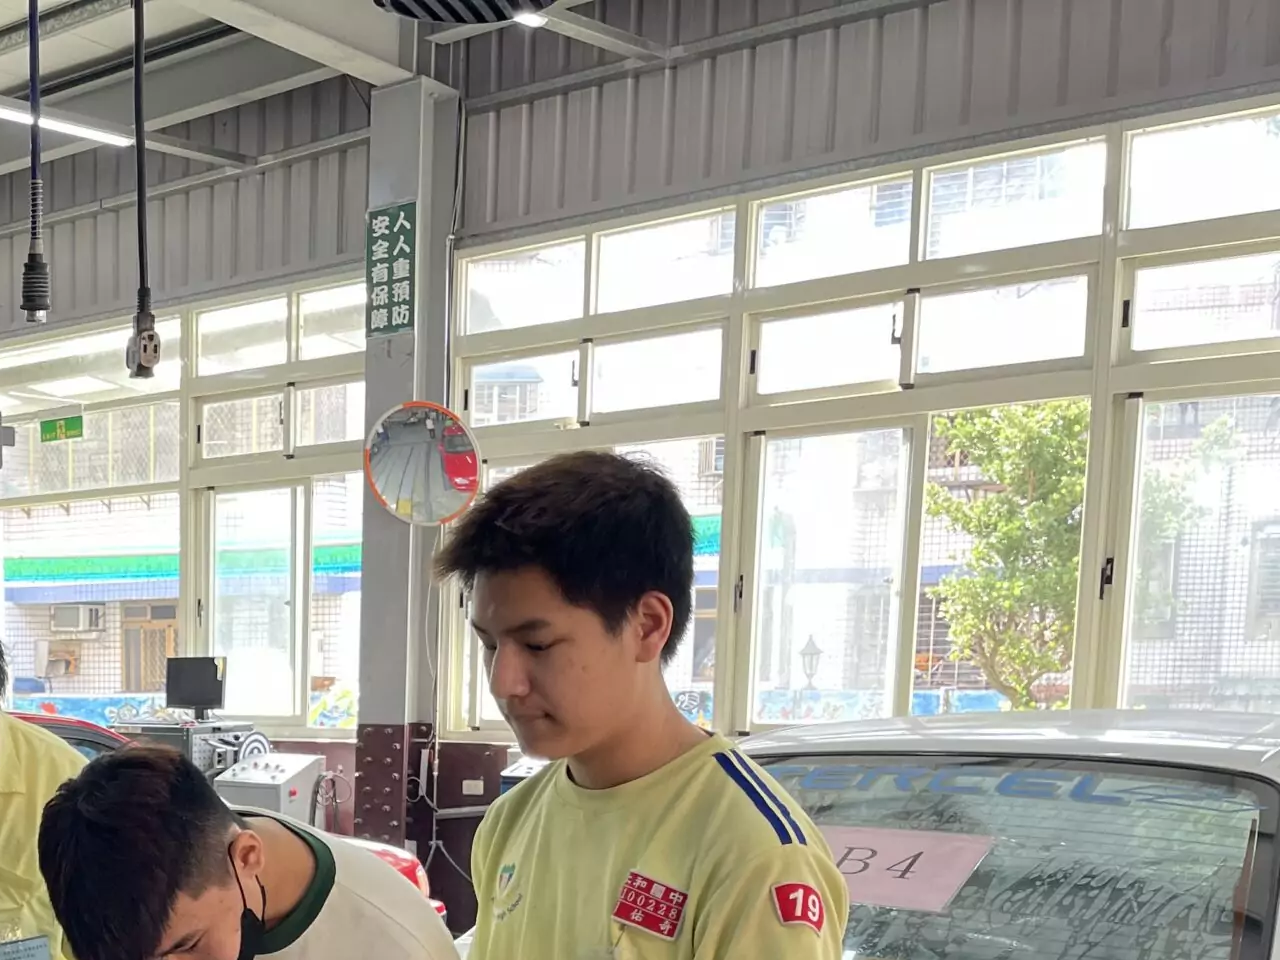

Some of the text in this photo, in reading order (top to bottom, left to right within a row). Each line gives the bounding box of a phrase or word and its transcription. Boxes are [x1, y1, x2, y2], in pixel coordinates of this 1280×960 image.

[371, 215, 390, 329] 安全有保障
[392, 211, 411, 326] 人人重預防
[789, 888, 820, 922] 19
